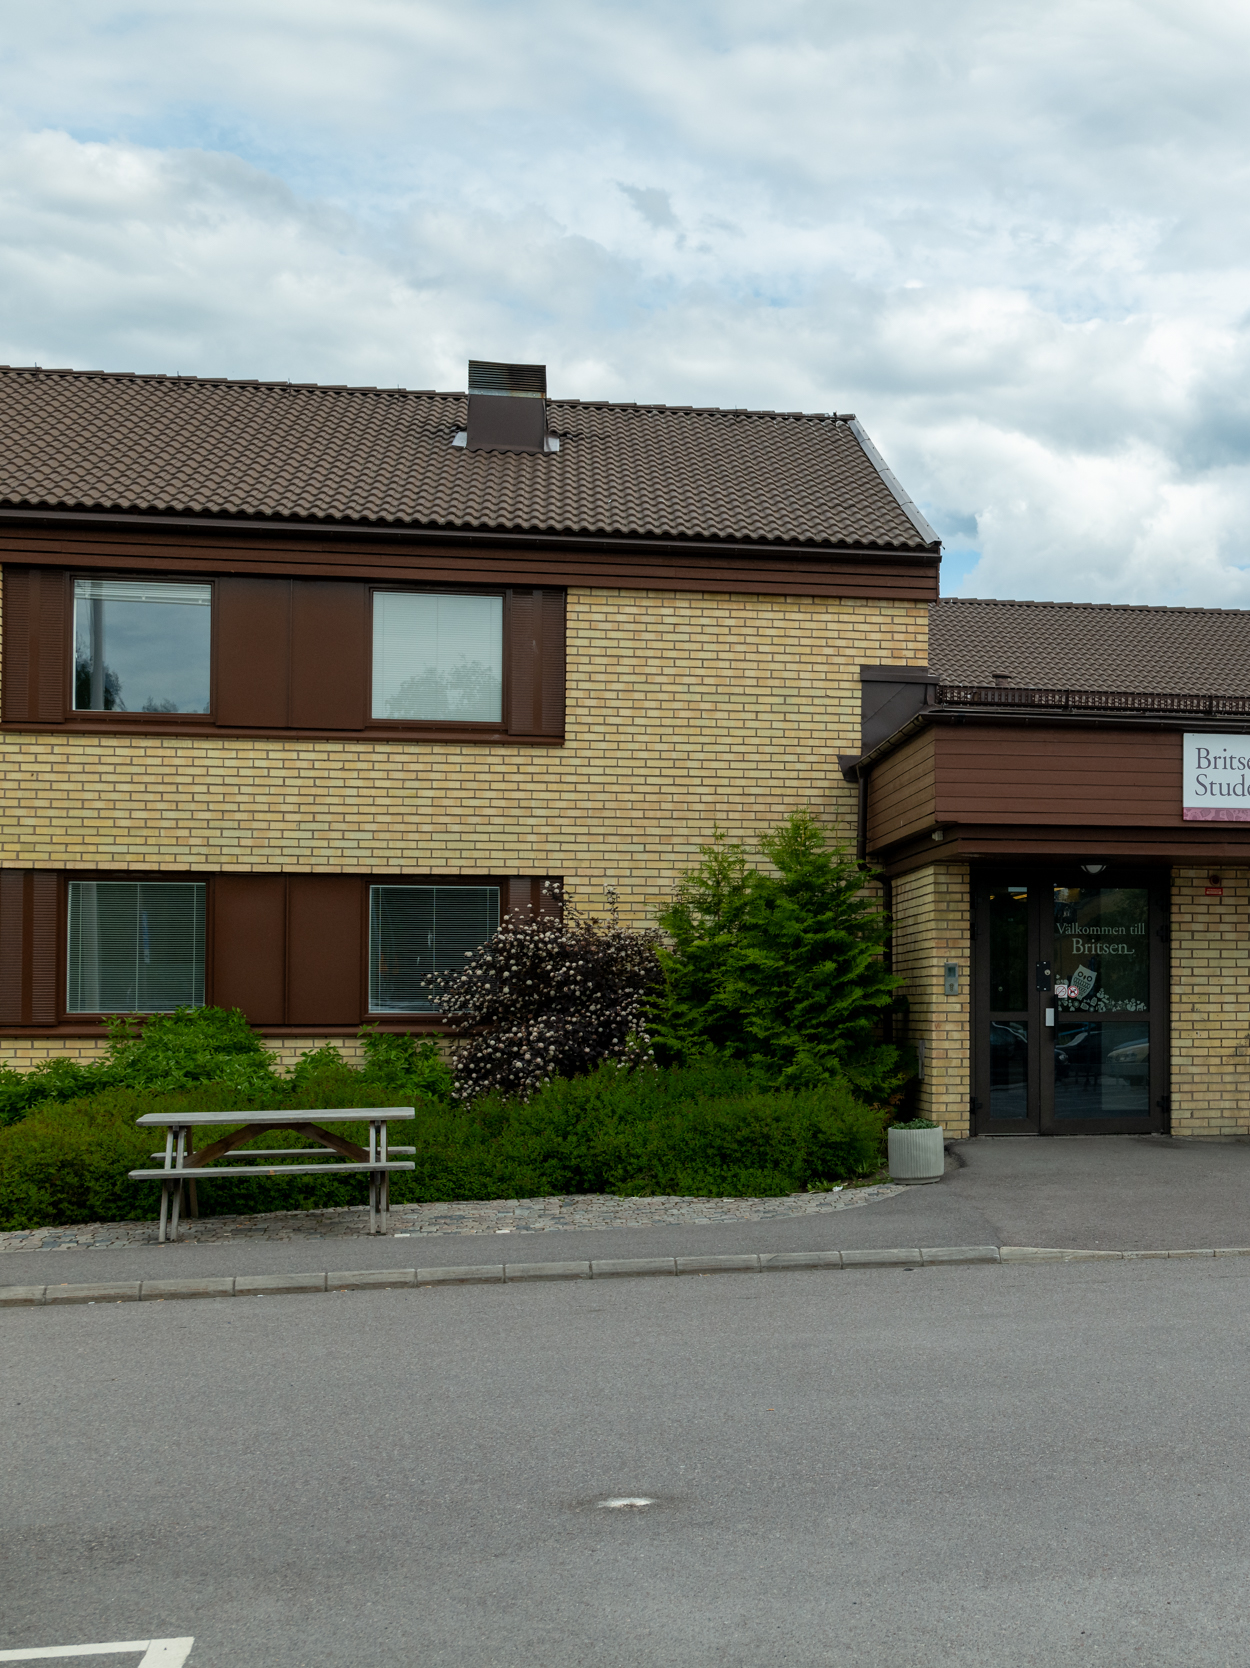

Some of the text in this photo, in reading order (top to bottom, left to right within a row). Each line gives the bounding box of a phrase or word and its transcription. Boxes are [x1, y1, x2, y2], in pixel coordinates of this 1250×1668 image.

[1056, 922, 1145, 935] Välkommen till
[1071, 937, 1135, 954] Britsen
